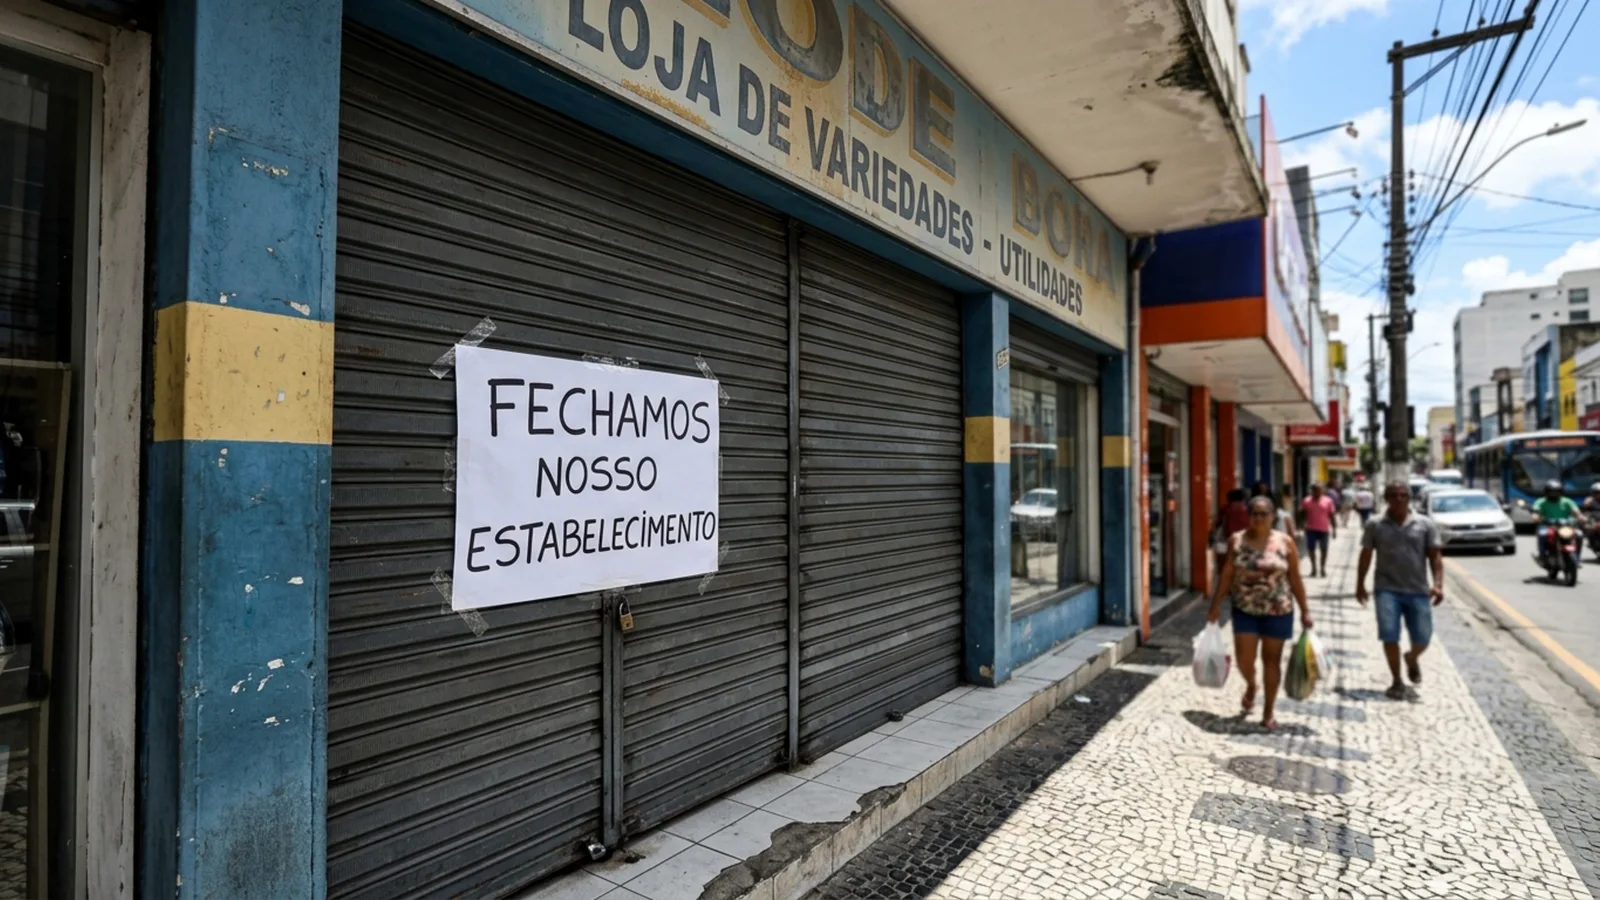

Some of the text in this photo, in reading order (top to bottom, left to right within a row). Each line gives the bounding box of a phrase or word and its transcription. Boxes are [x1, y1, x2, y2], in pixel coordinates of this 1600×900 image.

[681, 0, 956, 185] ODE
[569, 0, 721, 117] LOJA
[738, 63, 791, 156] DE
[805, 105, 974, 255] VARIEDADES
[1000, 233, 1083, 317] UTILIDADES
[488, 378, 711, 443] FECHAMOS
[536, 456, 657, 498] NOSSO
